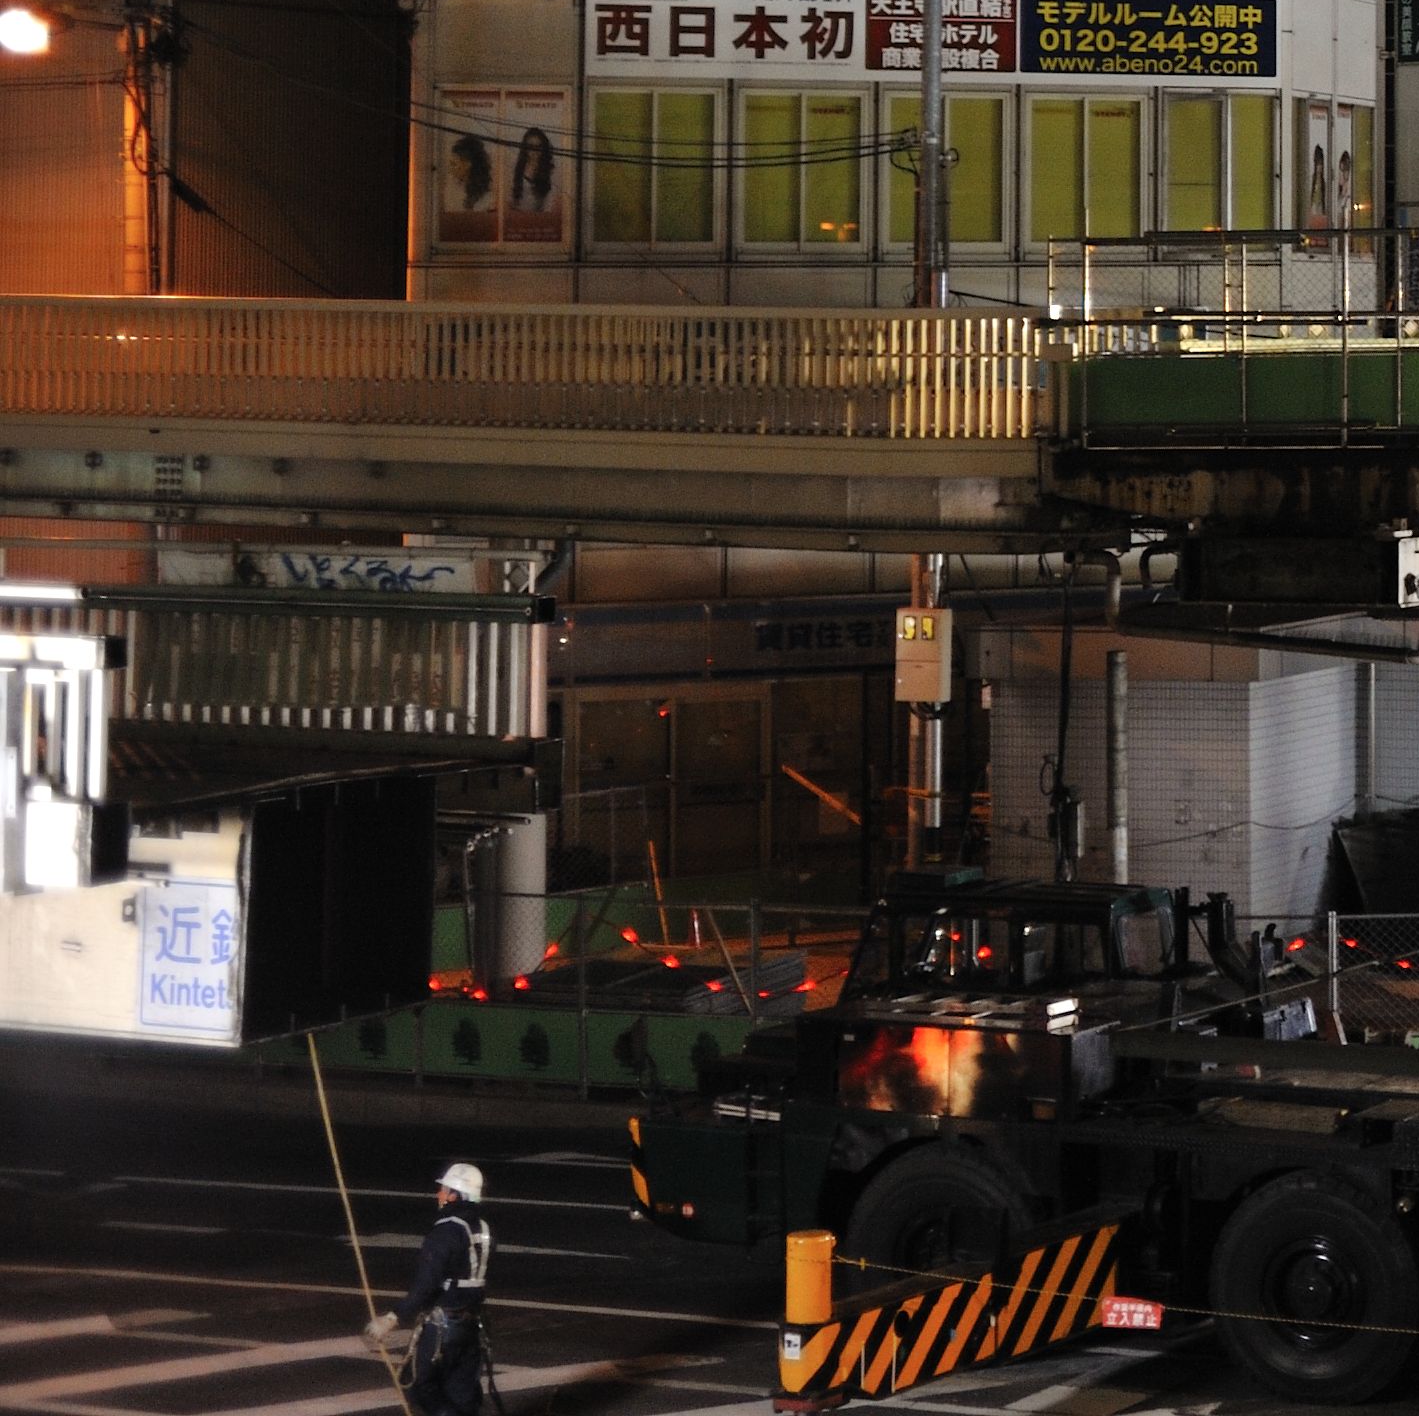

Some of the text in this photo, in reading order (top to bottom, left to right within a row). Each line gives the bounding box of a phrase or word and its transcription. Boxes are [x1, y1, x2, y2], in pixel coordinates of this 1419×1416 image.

[1036, 0, 1264, 32] モデルルーム公開中
[595, 3, 855, 61] 西日本初
[1038, 28, 1260, 57] 0120-244-923
[881, 46, 1001, 71] 商業設複合
[1039, 53, 1259, 77] www.abeno24.com
[1105, 1312, 1158, 1327] 立入禁止
